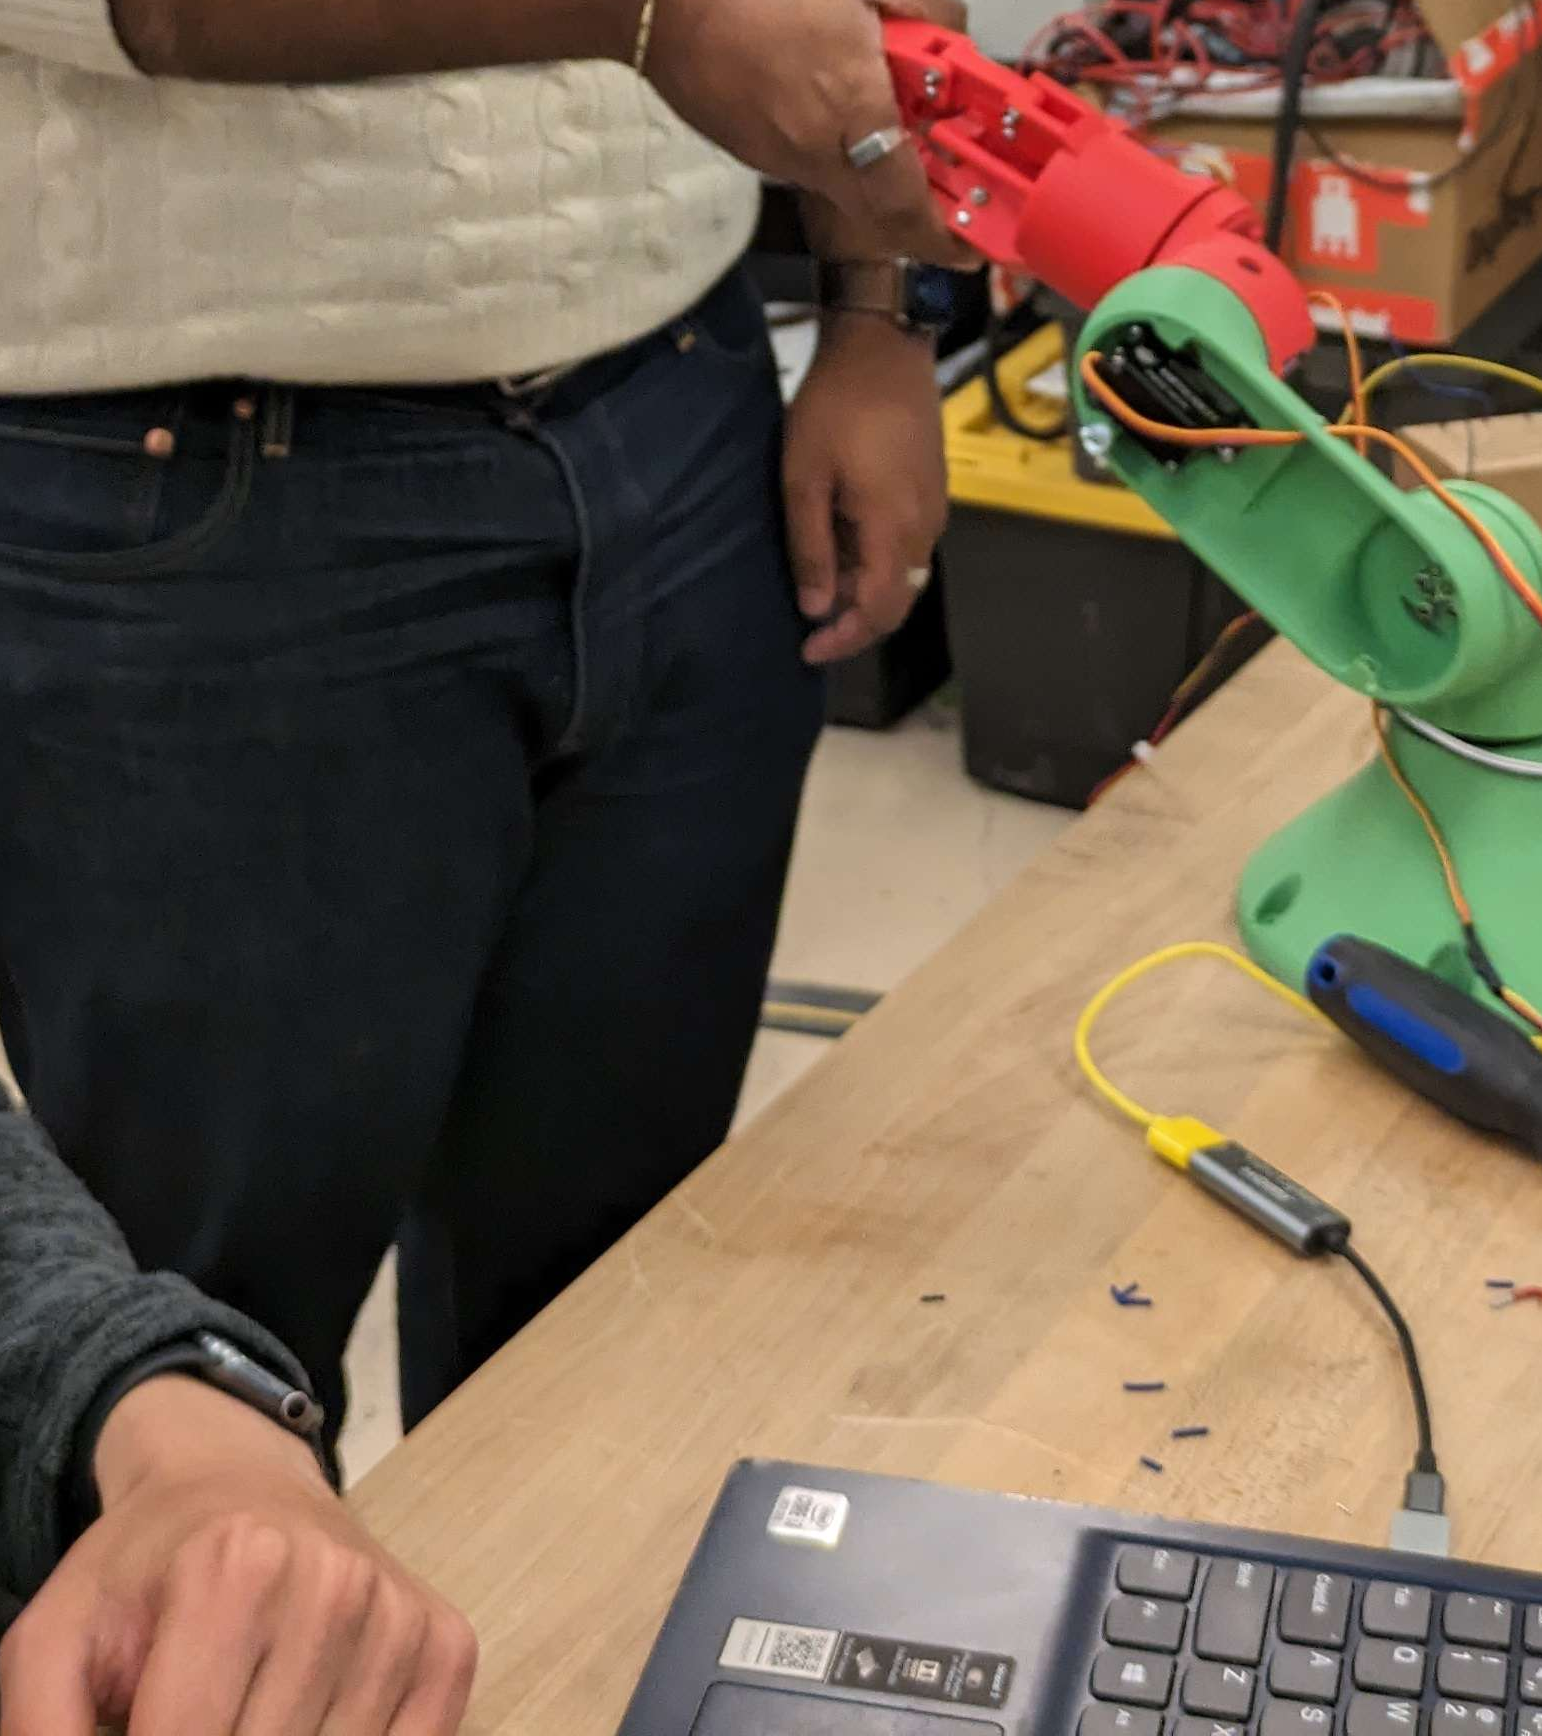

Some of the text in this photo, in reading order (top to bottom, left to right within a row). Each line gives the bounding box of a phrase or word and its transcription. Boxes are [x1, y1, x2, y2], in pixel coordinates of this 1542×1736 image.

[1309, 1650, 1333, 1667] A
[1393, 1646, 1419, 1664] Q
[1223, 1667, 1248, 1685] Z
[1300, 1705, 1327, 1723] S
[1386, 1701, 1412, 1723] W
[1445, 1703, 1469, 1718] 2
